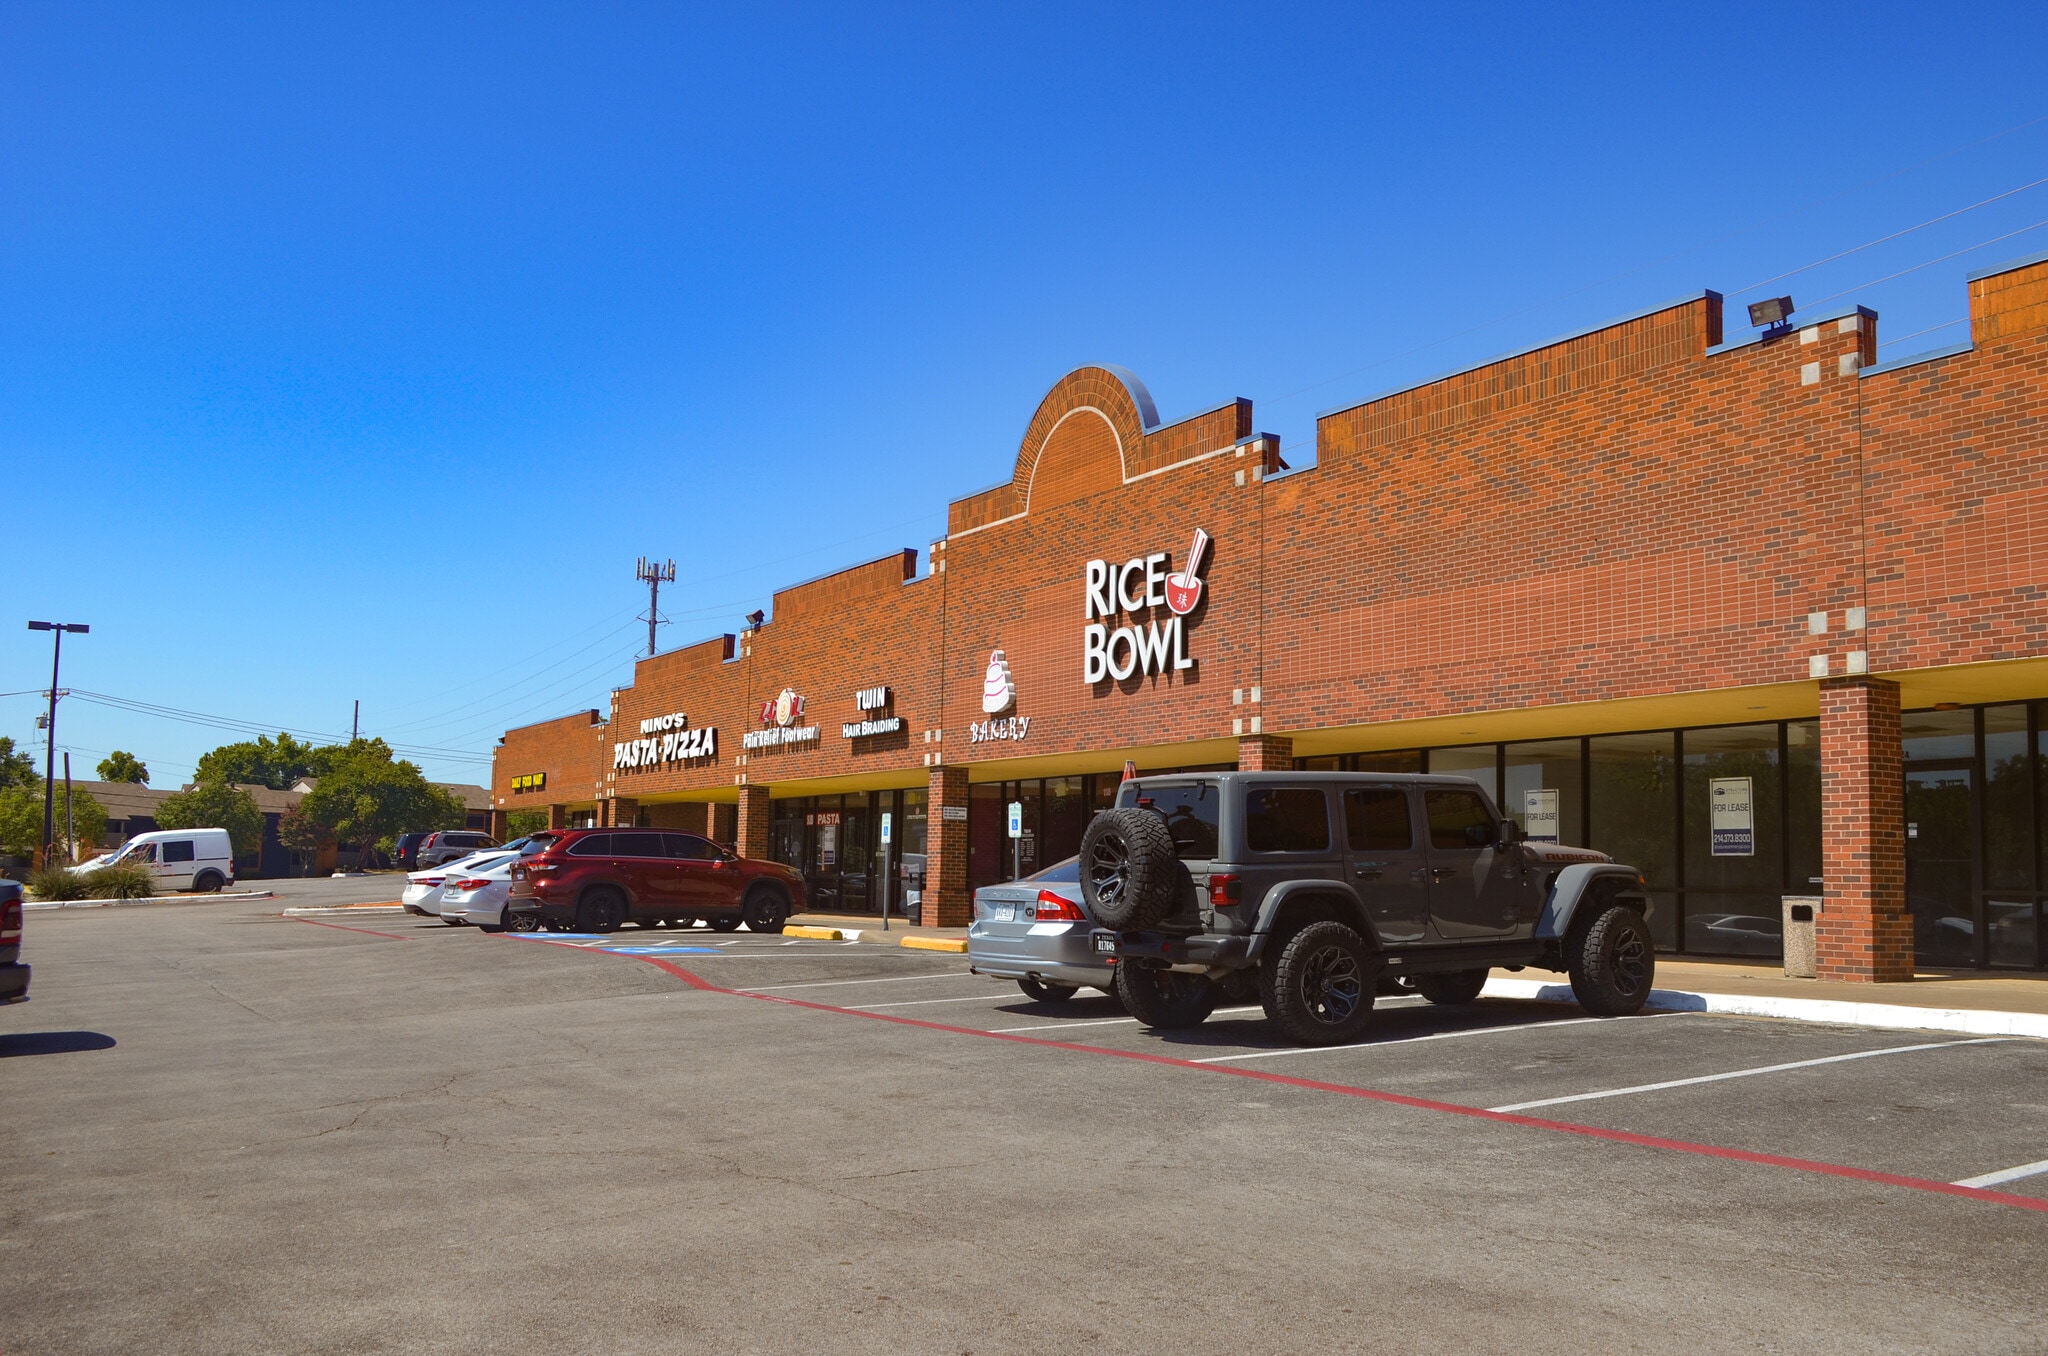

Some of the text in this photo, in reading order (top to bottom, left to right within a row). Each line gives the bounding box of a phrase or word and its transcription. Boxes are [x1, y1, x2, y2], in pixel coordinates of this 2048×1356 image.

[1085, 553, 1166, 619] RICE
[1084, 616, 1193, 684] BOWL
[856, 686, 887, 711] TWIN
[640, 712, 687, 734] NINO'S
[842, 717, 900, 738] HAIR BRAIDING
[970, 716, 1031, 743] BAKERY
[758, 727, 780, 746] Relief
[781, 725, 817, 744] Footwear
[613, 726, 715, 770] PASTA PIZZA
[1528, 812, 1556, 821] FOR LEASE
[1714, 803, 1749, 812] FOR LEASE
[817, 812, 840, 825] PASTA
[1545, 853, 1605, 862] RUBICON
